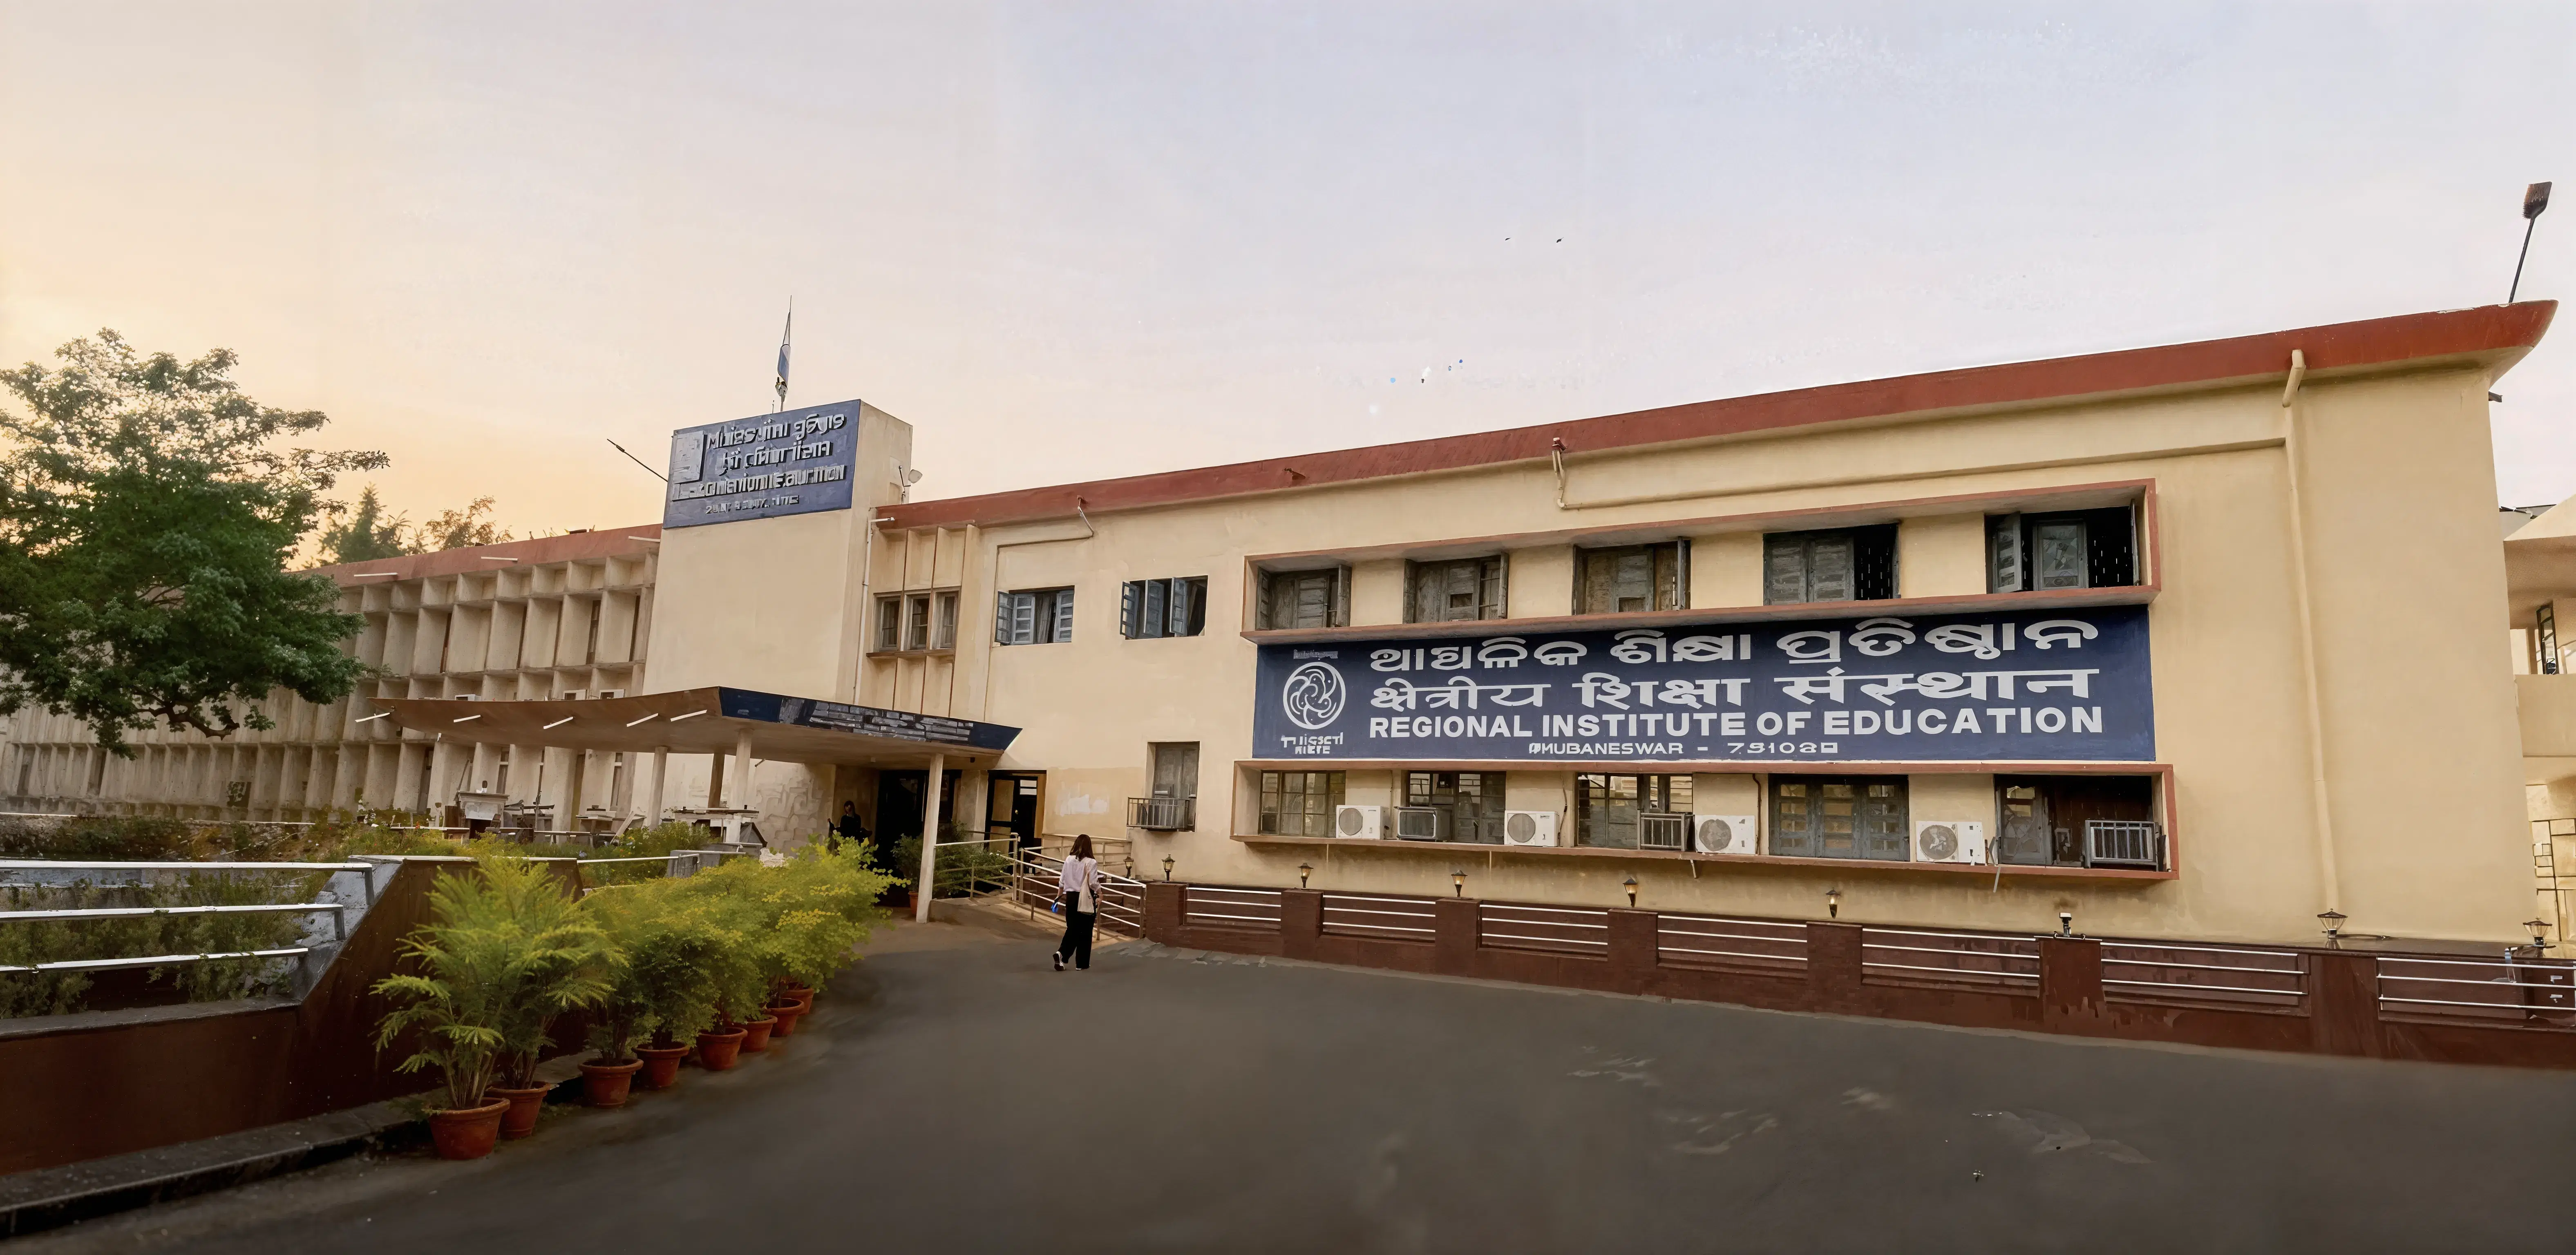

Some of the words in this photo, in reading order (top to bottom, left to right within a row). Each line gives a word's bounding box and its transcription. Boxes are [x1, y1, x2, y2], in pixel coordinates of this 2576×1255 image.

[1370, 675, 1552, 712] क्षेत्रीय
[1773, 666, 2100, 706] संस्थान
[1369, 715, 1532, 738] REGIONAL
[1543, 712, 1746, 737] INSTITUTE
[1756, 711, 1811, 736] OF
[1824, 706, 2103, 735] EDUCATION
